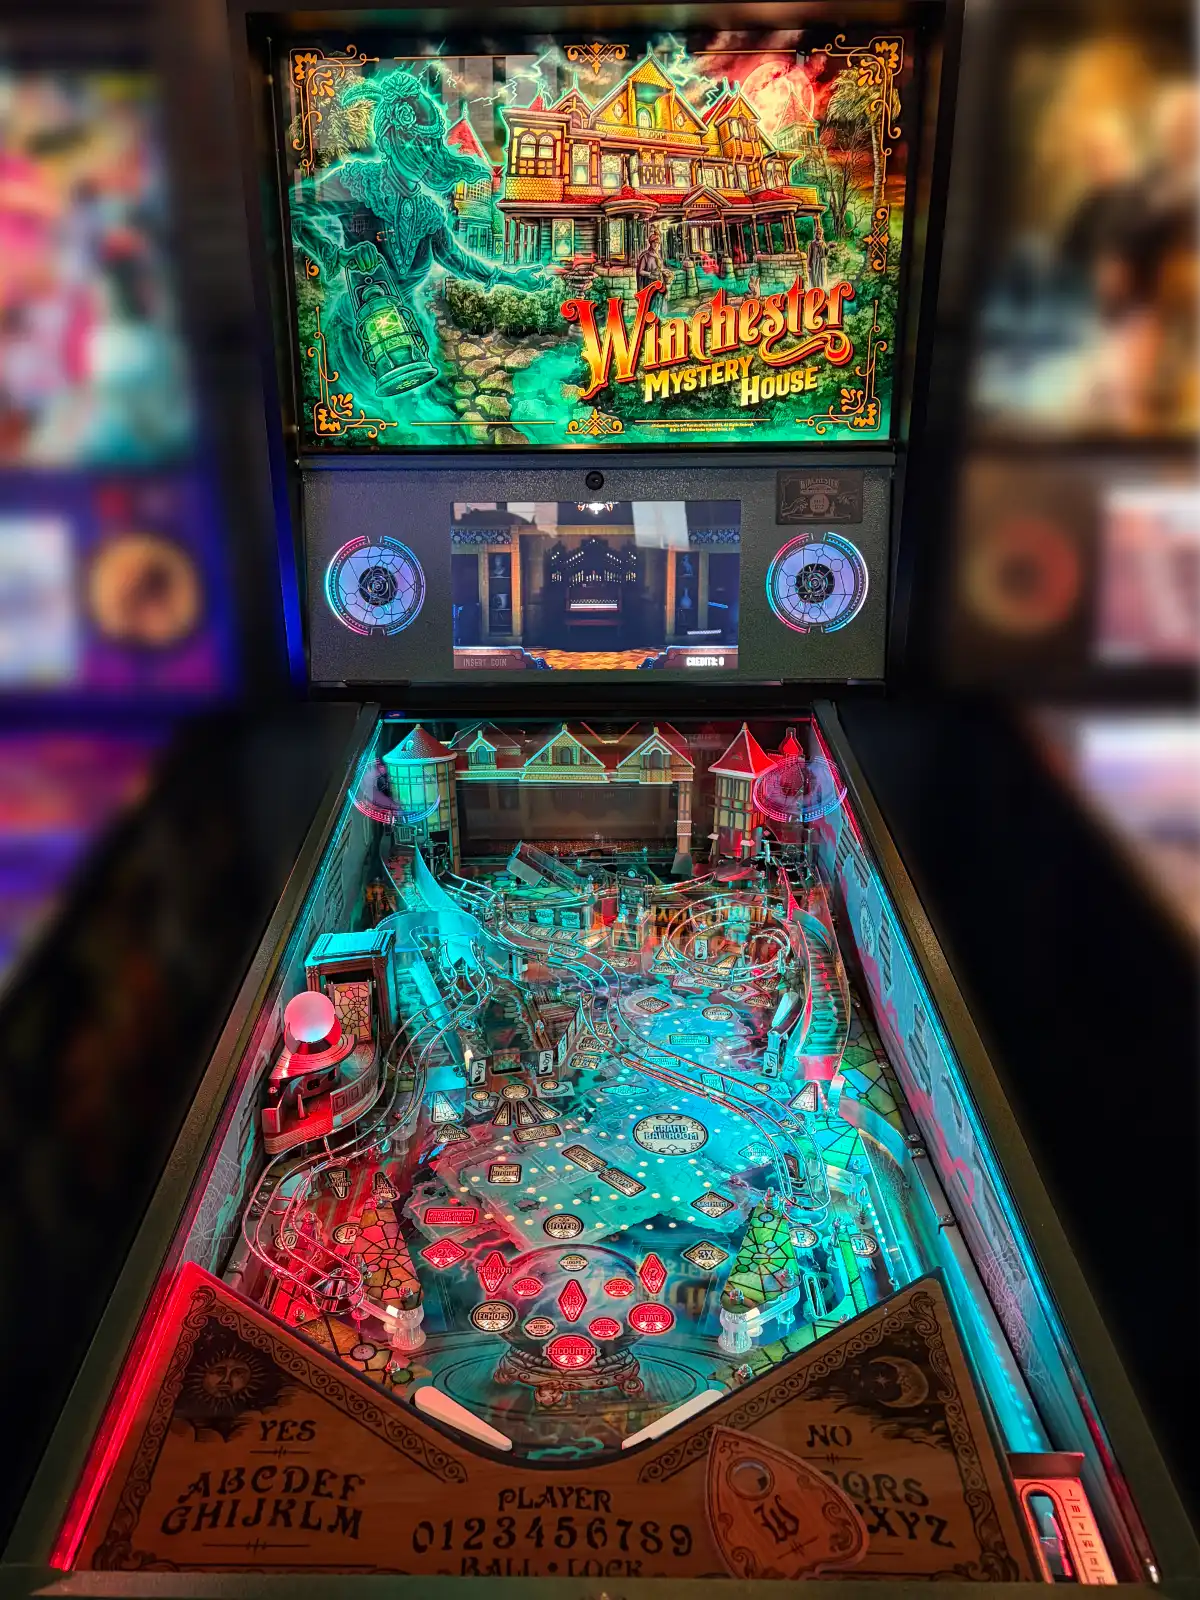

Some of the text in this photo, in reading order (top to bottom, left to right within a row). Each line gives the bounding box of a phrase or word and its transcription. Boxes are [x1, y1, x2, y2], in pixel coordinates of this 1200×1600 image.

[560, 276, 855, 400] Winchester
[644, 355, 754, 403] MYSTERY
[740, 365, 819, 407] HOUSE
[463, 657, 508, 668] INSERT COIN
[653, 1124, 688, 1133] GRAND
[644, 1132, 699, 1141] BALLROOM
[550, 1222, 578, 1231] FOYER
[436, 1248, 452, 1258] 2X
[698, 1249, 714, 1260] 3X
[478, 1311, 509, 1321] ECHOES
[639, 1313, 665, 1323] EVADE
[547, 1346, 597, 1356] ENCOUNTER
[259, 1419, 317, 1442] YES
[806, 1424, 853, 1448] NO
[178, 1465, 366, 1504] ABCDEF
[497, 1485, 613, 1514] PLAYER
[160, 1498, 364, 1541] GHIJKLM
